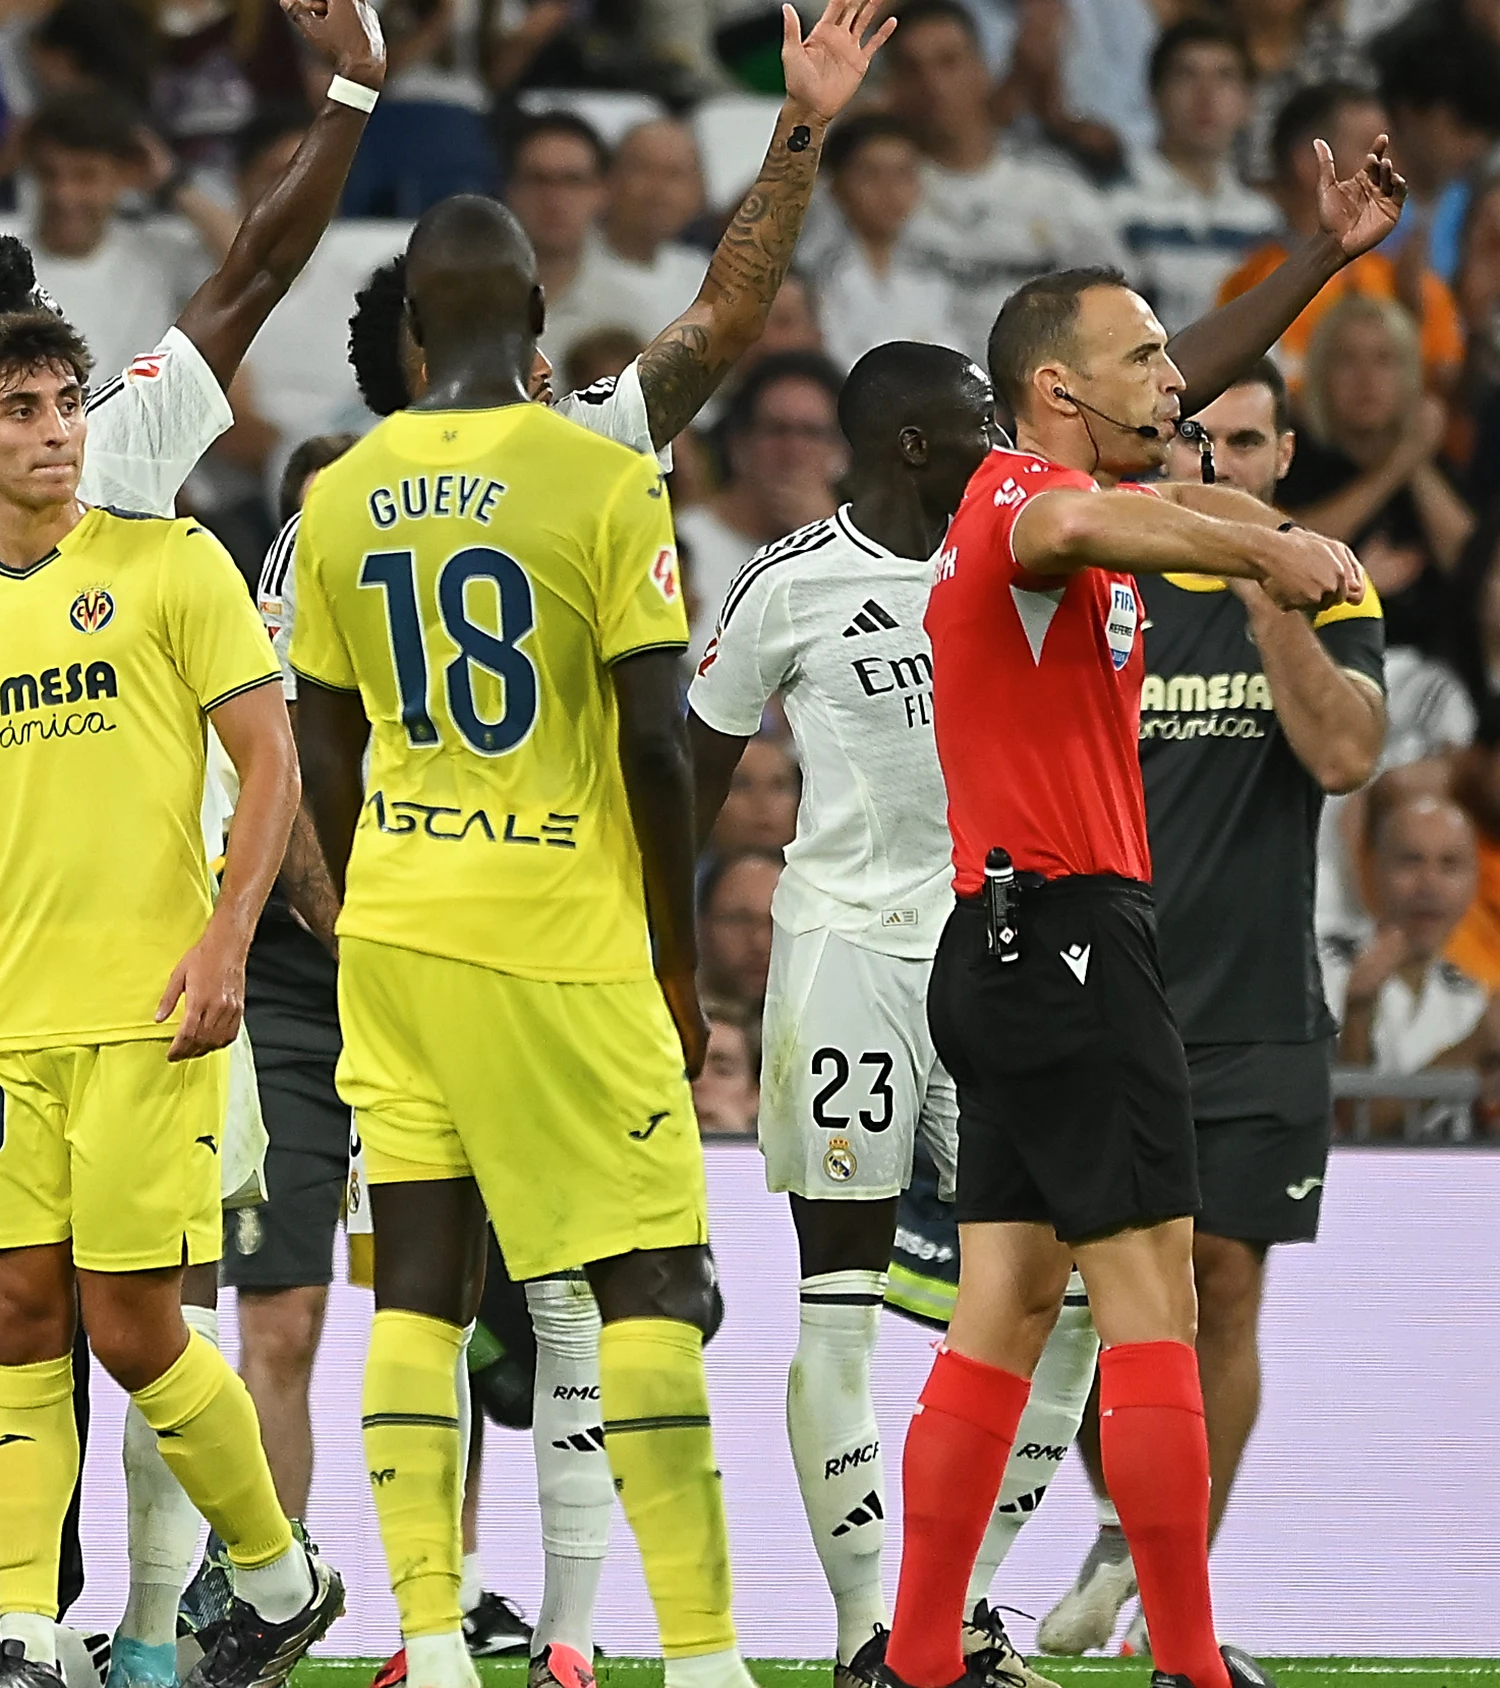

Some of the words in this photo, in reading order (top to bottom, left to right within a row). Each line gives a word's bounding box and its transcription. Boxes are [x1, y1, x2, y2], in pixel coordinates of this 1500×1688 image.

[369, 475, 505, 528] GUEYE
[1114, 590, 1134, 613] FIFA
[359, 546, 538, 753] 18
[851, 653, 933, 697] Em
[1140, 671, 1274, 712] AMESA
[904, 691, 934, 729] FL
[1138, 713, 1265, 741] rámica
[811, 1047, 894, 1133] 23
[552, 1385, 601, 1401] RMC
[1016, 1442, 1069, 1461] RMC
